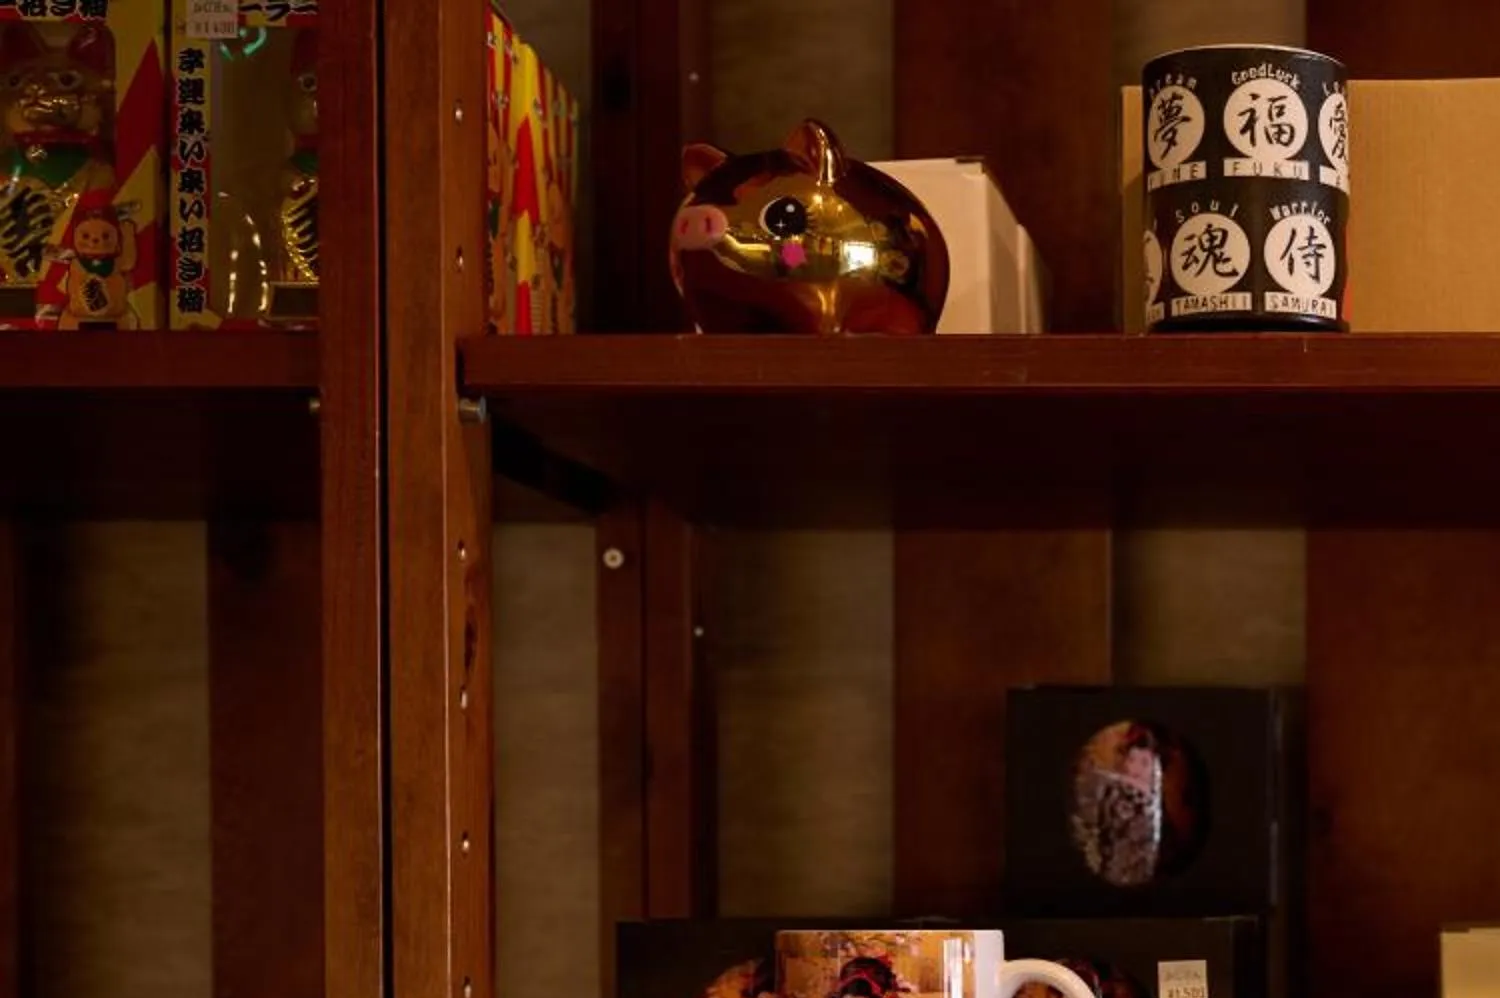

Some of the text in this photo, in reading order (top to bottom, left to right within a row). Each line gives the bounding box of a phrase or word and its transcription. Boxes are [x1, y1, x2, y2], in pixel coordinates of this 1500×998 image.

[1153, 91, 1193, 161] 夢
[1237, 92, 1297, 148] 福
[1231, 160, 1304, 178] FUKU
[1174, 200, 1241, 224] Soul
[1268, 202, 1332, 226] Warrior
[1180, 223, 1240, 279] 魂
[1279, 225, 1328, 286] 侍
[1174, 294, 1249, 313] TAMASHII
[1267, 298, 1335, 317] SAMURAI
